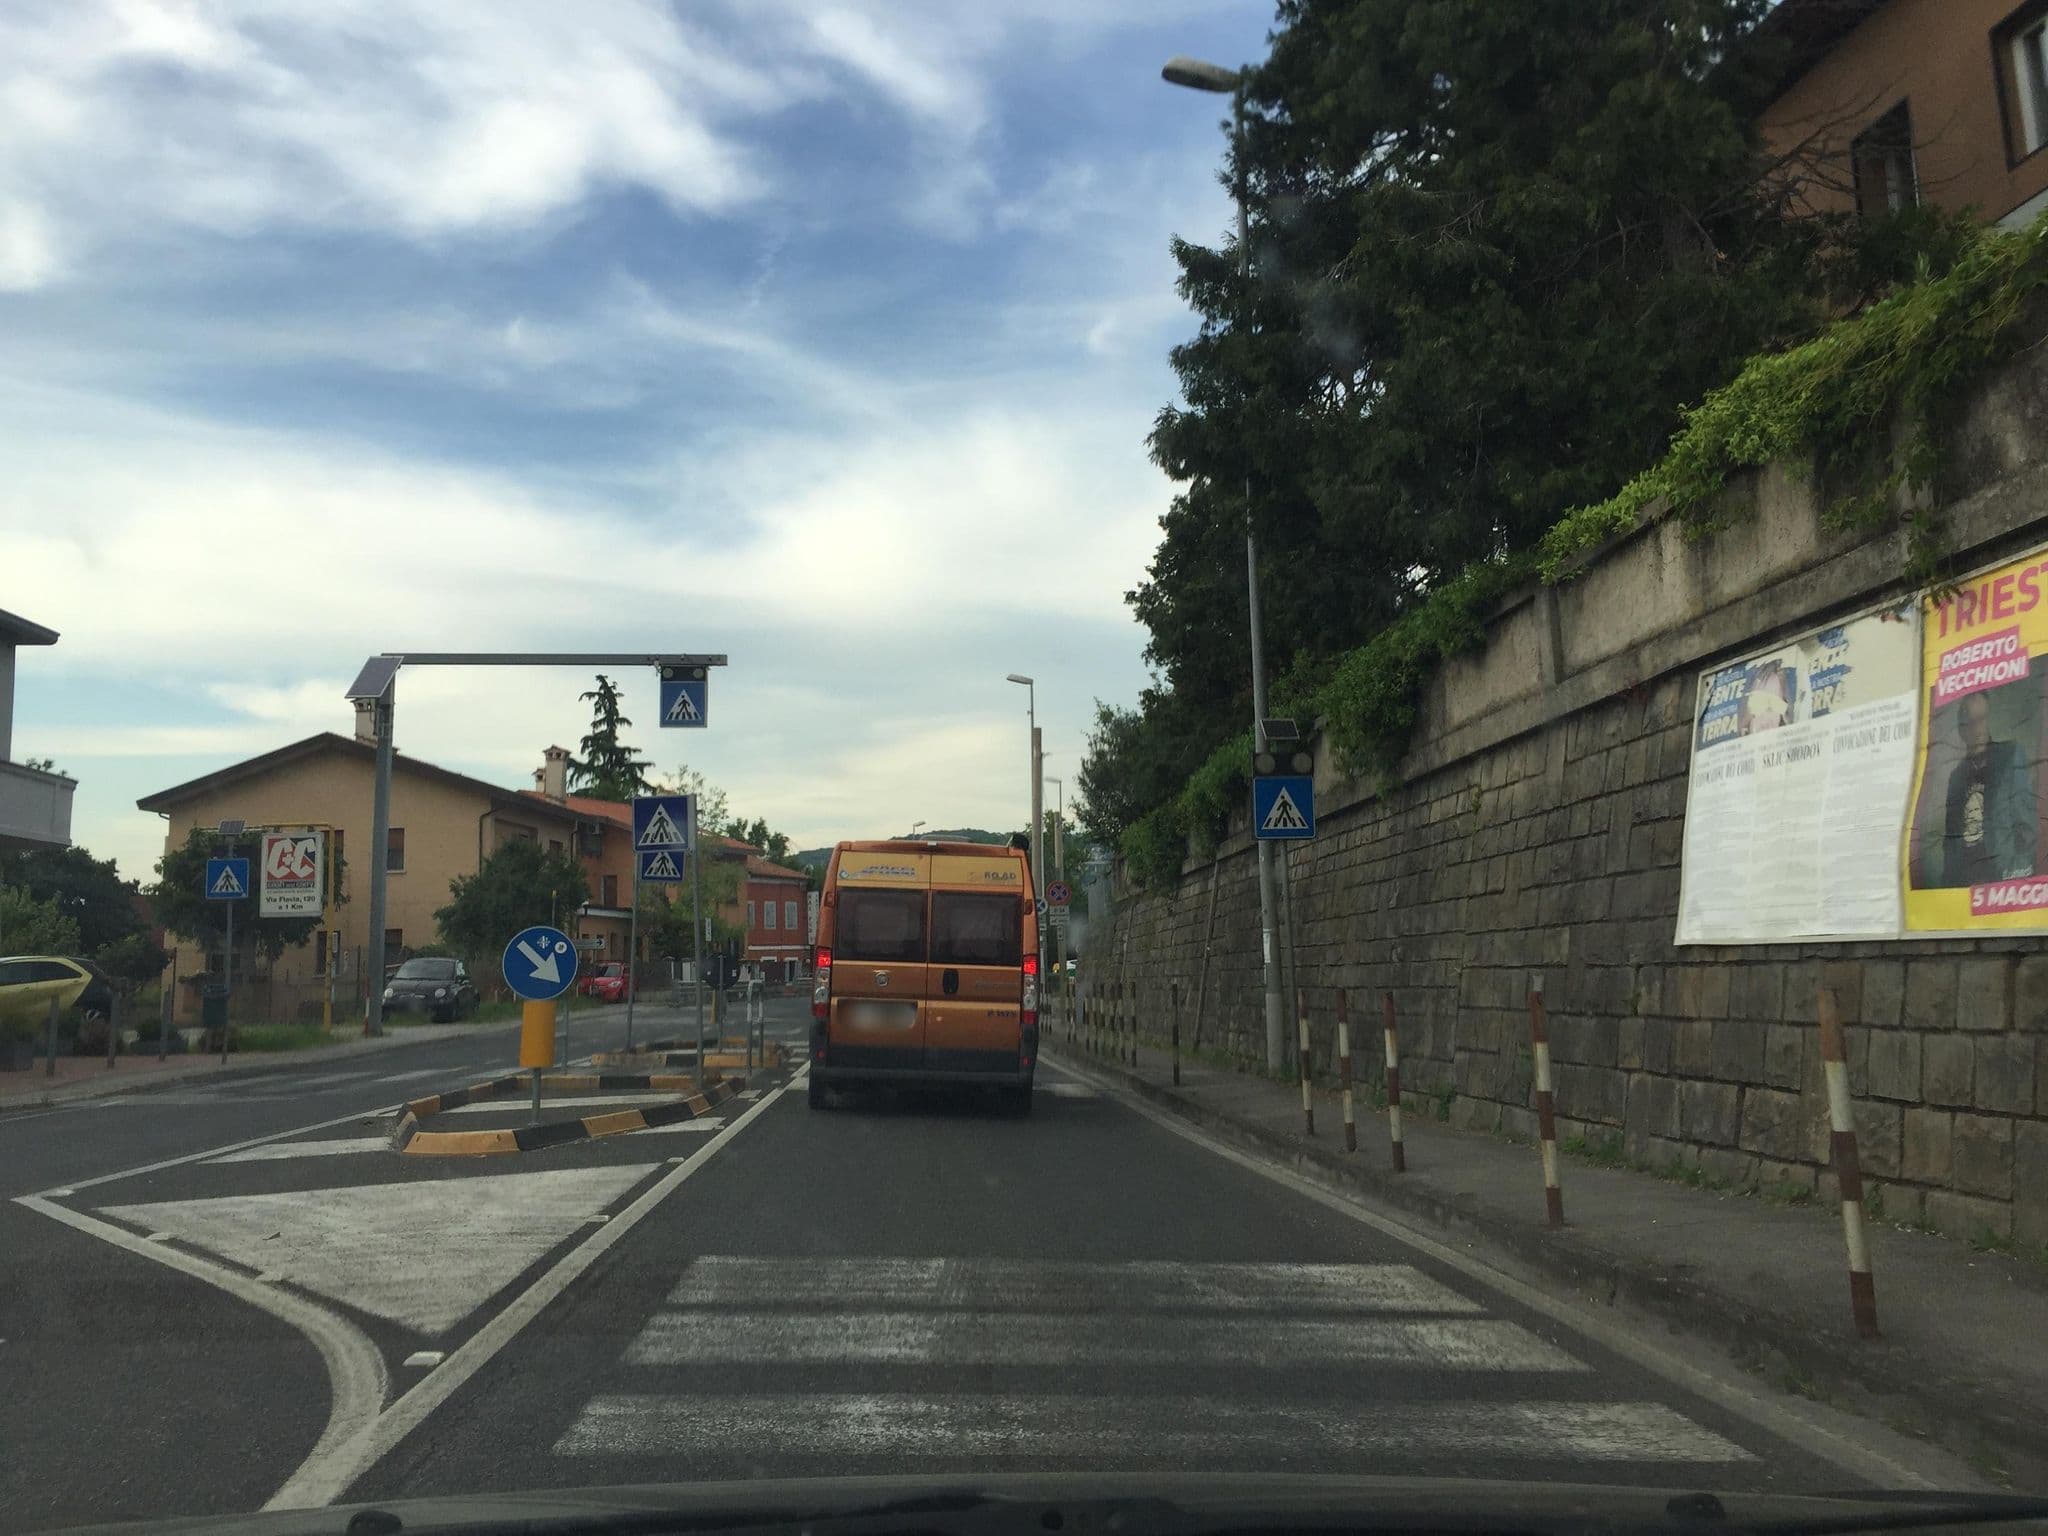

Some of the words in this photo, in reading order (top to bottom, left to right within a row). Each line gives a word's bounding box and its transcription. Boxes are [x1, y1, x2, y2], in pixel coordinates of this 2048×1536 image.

[1941, 634, 2017, 672] ROBERTO
[1938, 655, 2027, 696] VECCHIONI
[1972, 887, 1985, 908] 5
